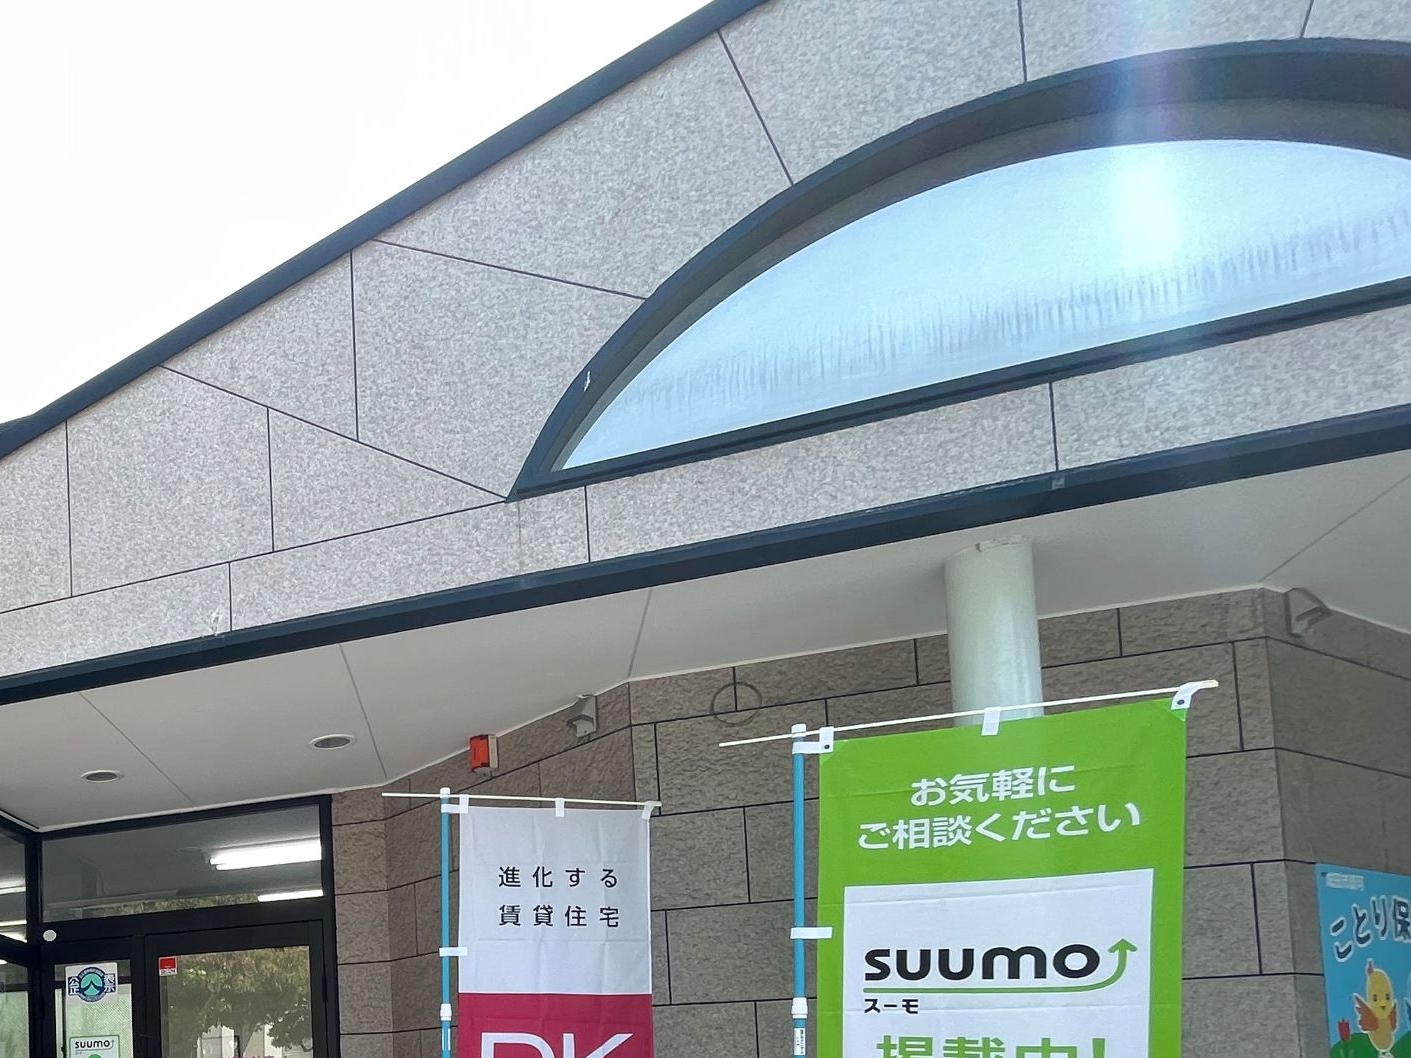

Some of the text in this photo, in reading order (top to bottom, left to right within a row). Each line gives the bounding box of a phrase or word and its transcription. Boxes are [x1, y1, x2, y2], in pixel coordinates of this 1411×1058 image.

[910, 764, 1076, 807] お気軽に
[858, 802, 1141, 850] ご相談ください
[497, 865, 619, 888] 進化する
[497, 904, 620, 928] 賃貸住宅
[864, 943, 1101, 981] suumo
[863, 998, 920, 1015] スーモ
